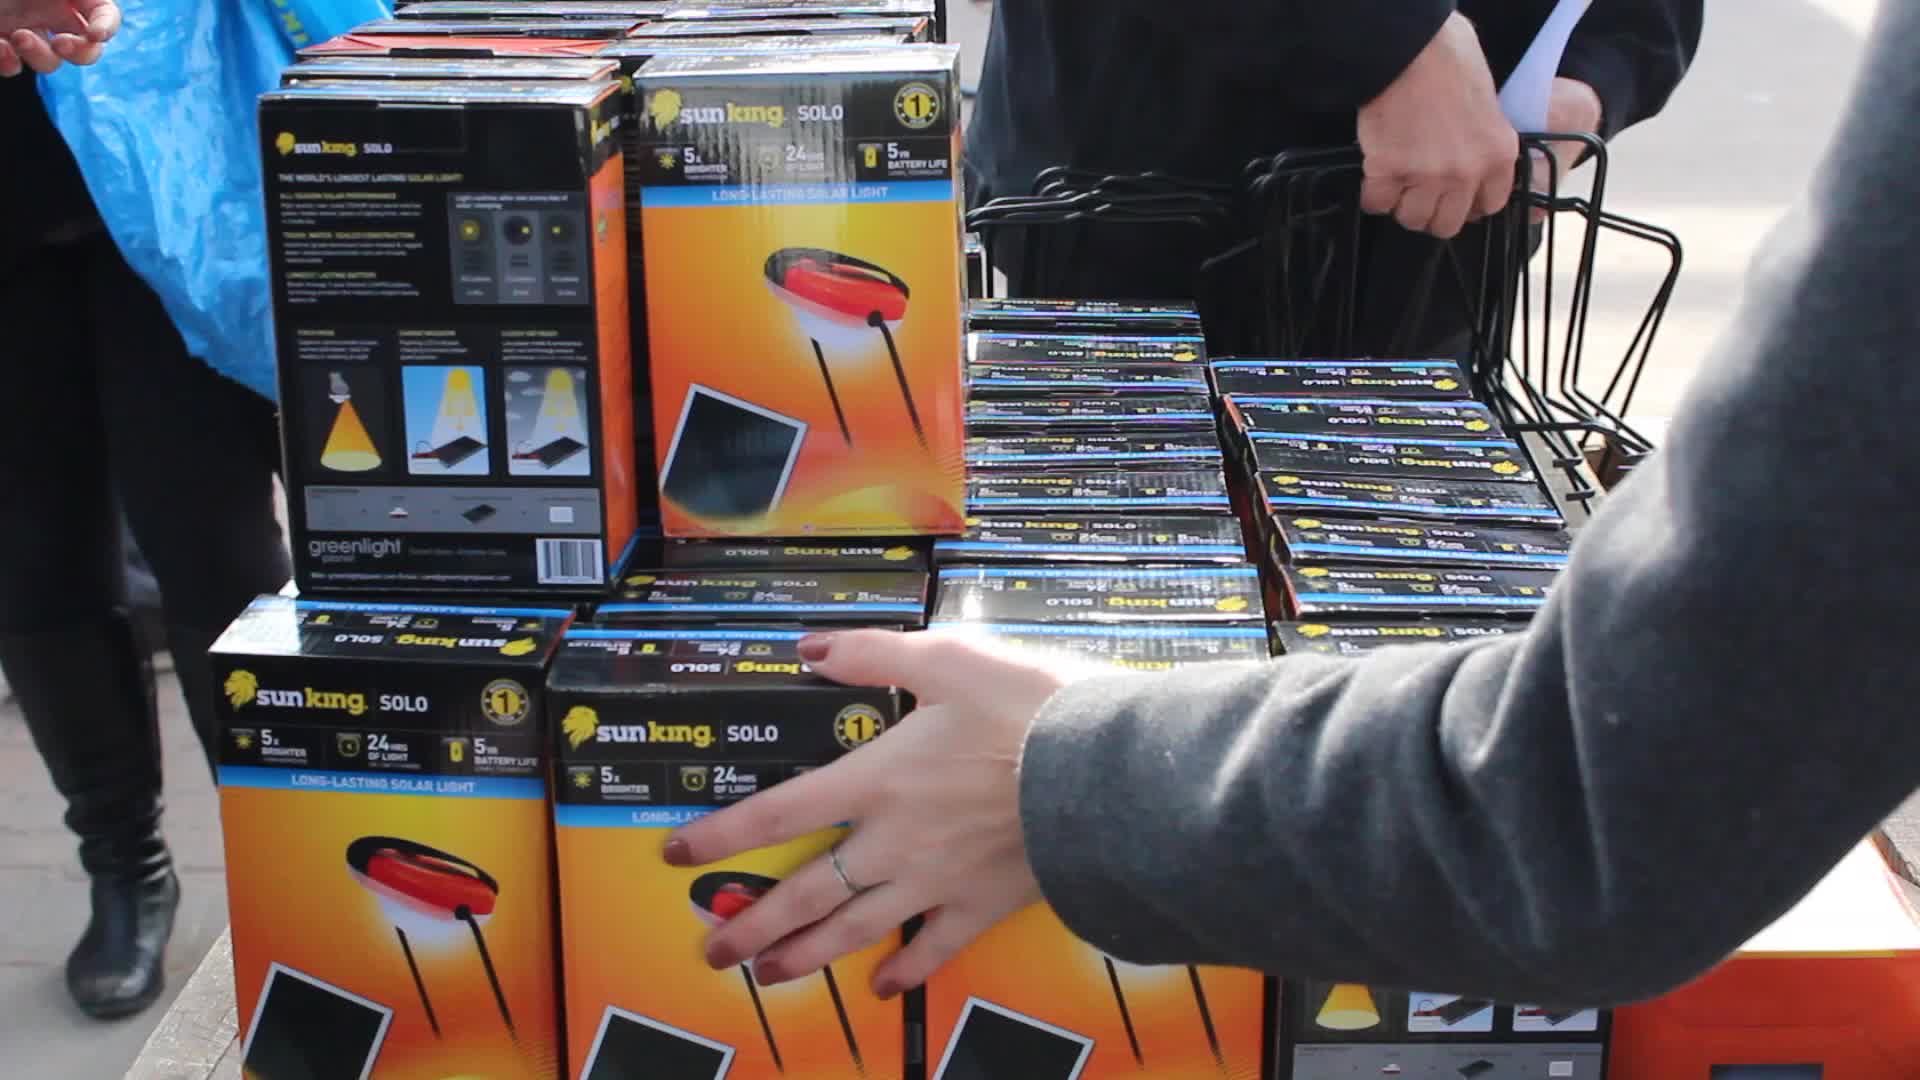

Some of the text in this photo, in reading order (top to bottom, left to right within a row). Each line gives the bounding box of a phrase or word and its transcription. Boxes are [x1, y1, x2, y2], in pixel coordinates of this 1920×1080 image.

[909, 95, 921, 117] 1
[798, 105, 844, 121] SOLO
[363, 143, 393, 154] SOLO
[684, 164, 728, 174] BRIGHTER
[887, 160, 948, 169] BATTERY LIFE
[851, 185, 888, 198] LIGHT
[309, 538, 401, 557] greenlight
[1046, 598, 1093, 606] SOLO
[334, 634, 384, 644] SOLO
[670, 663, 722, 673] SOLO
[380, 694, 428, 712] SOLO
[497, 691, 509, 714] 1
[728, 725, 778, 742] SOLO
[851, 716, 863, 740] 1
[261, 747, 308, 758] BRIGHTER
[368, 752, 408, 762] OF LIGHT
[474, 757, 538, 767] BATTERY LIFE
[292, 775, 475, 793] LONG-LASTING SOLAR LIGHT
[601, 784, 649, 794] BRIGHTER
[713, 784, 757, 794] OF LIGHT
